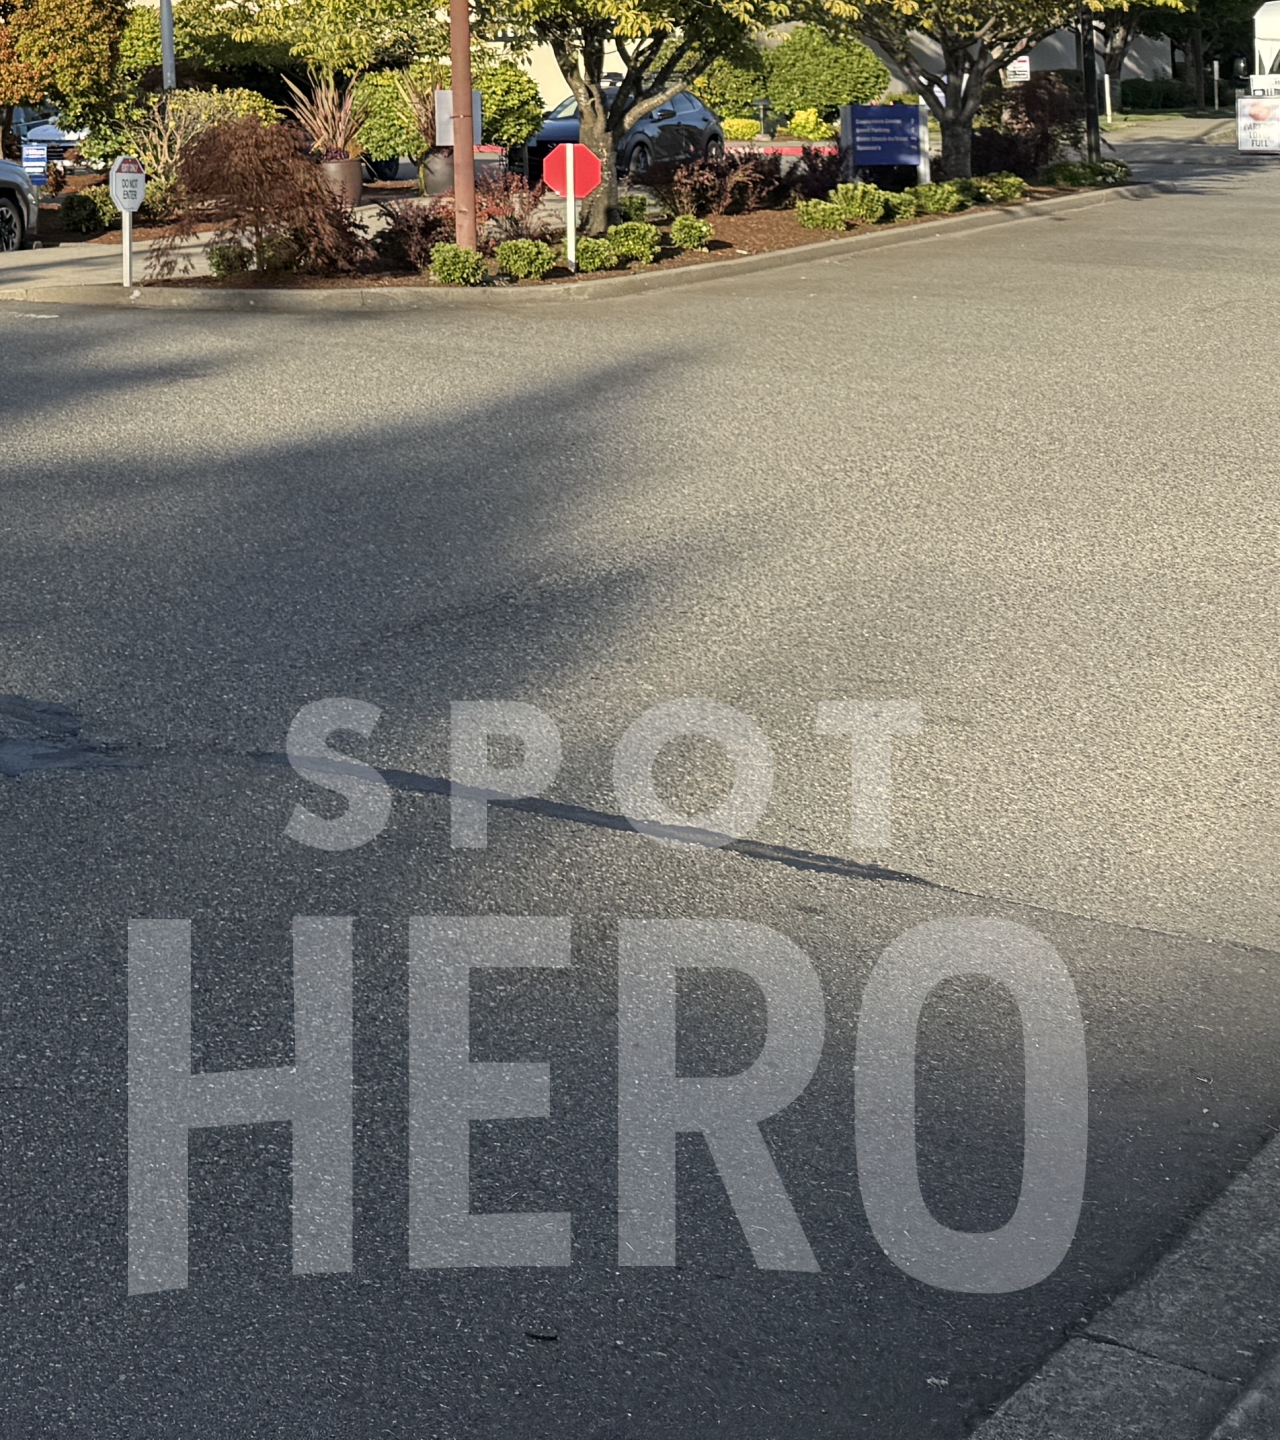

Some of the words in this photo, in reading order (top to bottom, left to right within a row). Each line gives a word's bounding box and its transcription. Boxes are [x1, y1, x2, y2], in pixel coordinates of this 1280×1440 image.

[1251, 139, 1268, 147] FULL
[122, 179, 129, 188] DO
[130, 179, 138, 188] NOT
[123, 190, 137, 199] ENTER
